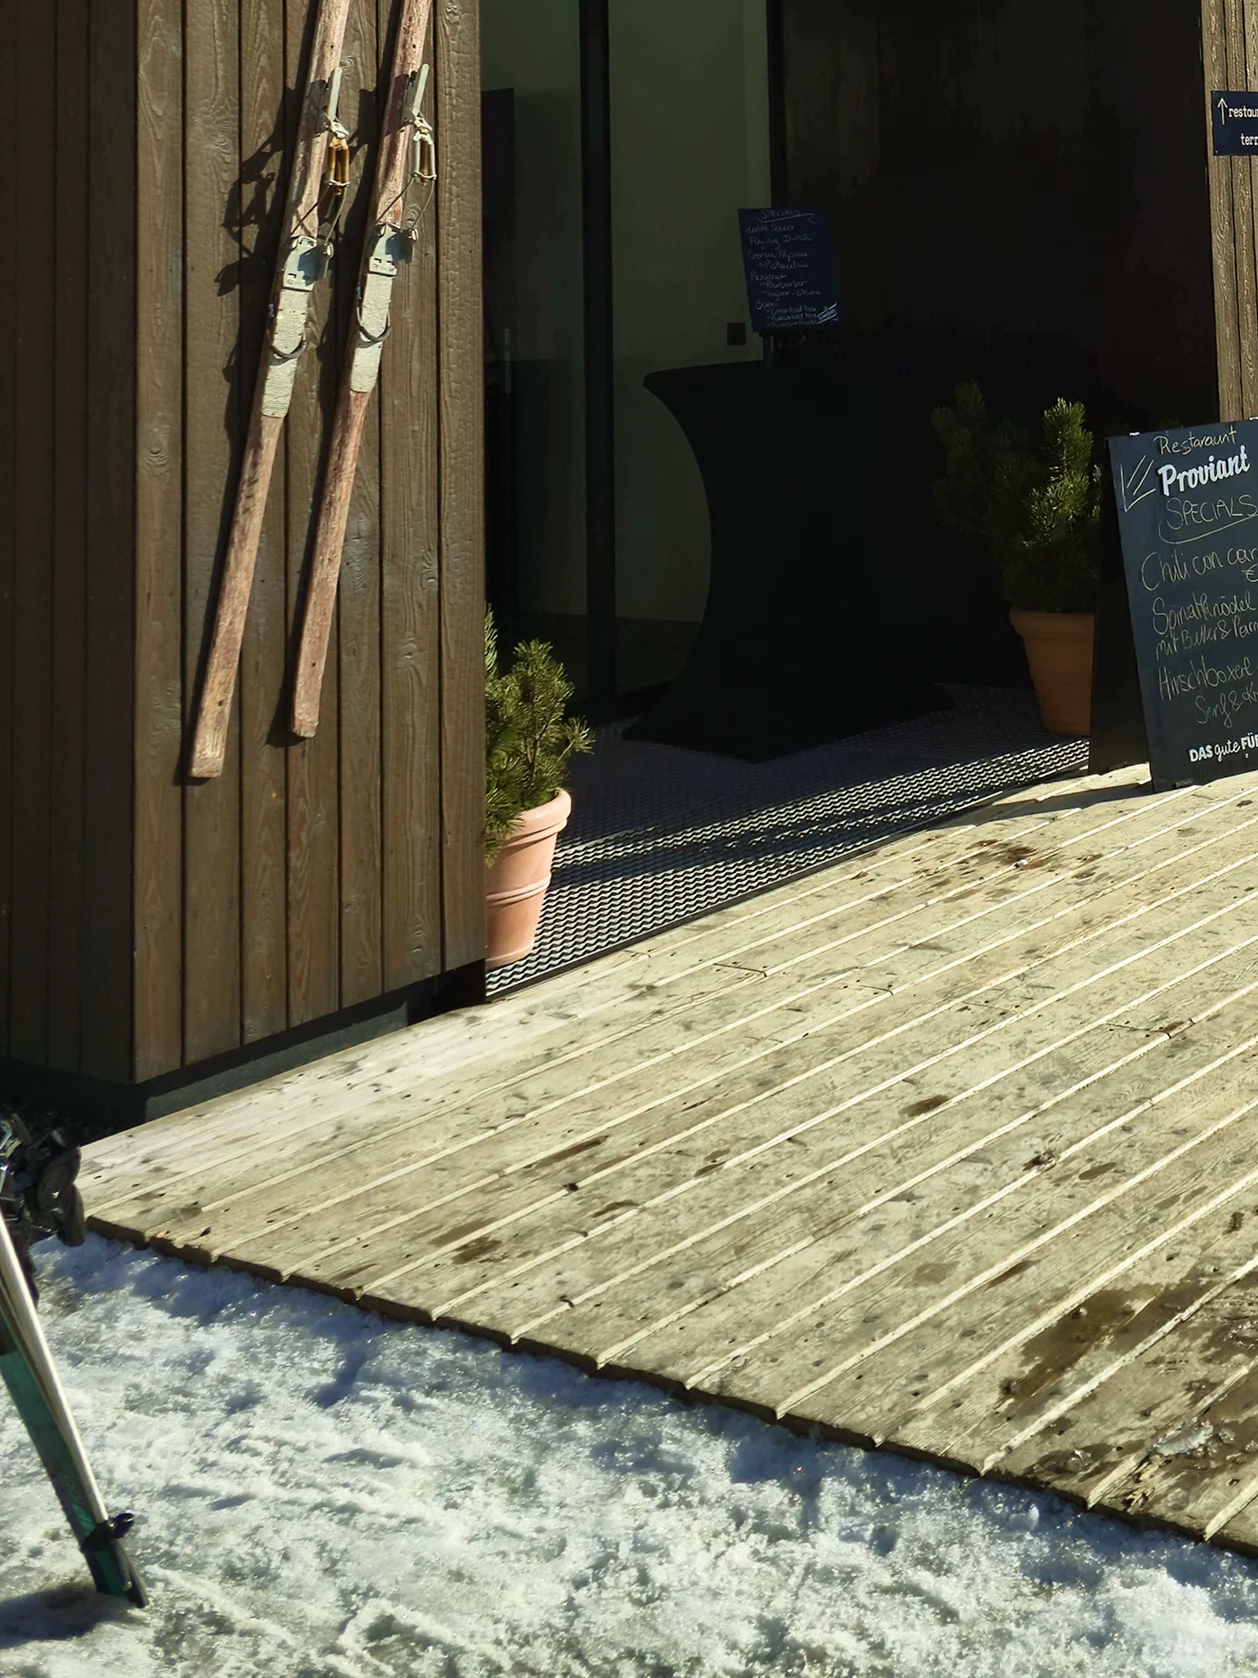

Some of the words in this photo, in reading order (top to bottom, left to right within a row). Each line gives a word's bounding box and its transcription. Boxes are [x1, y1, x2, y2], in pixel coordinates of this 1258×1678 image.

[1157, 444, 1250, 497] Proviant
[1166, 494, 1258, 531] SPECIALS
[1141, 548, 1190, 591] Chili
[1192, 551, 1224, 576] con
[1155, 634, 1179, 660] mit
[1217, 619, 1232, 640] &
[1194, 695, 1233, 728] Senf
[1188, 744, 1214, 763] DAS
[1214, 738, 1241, 762] gute
